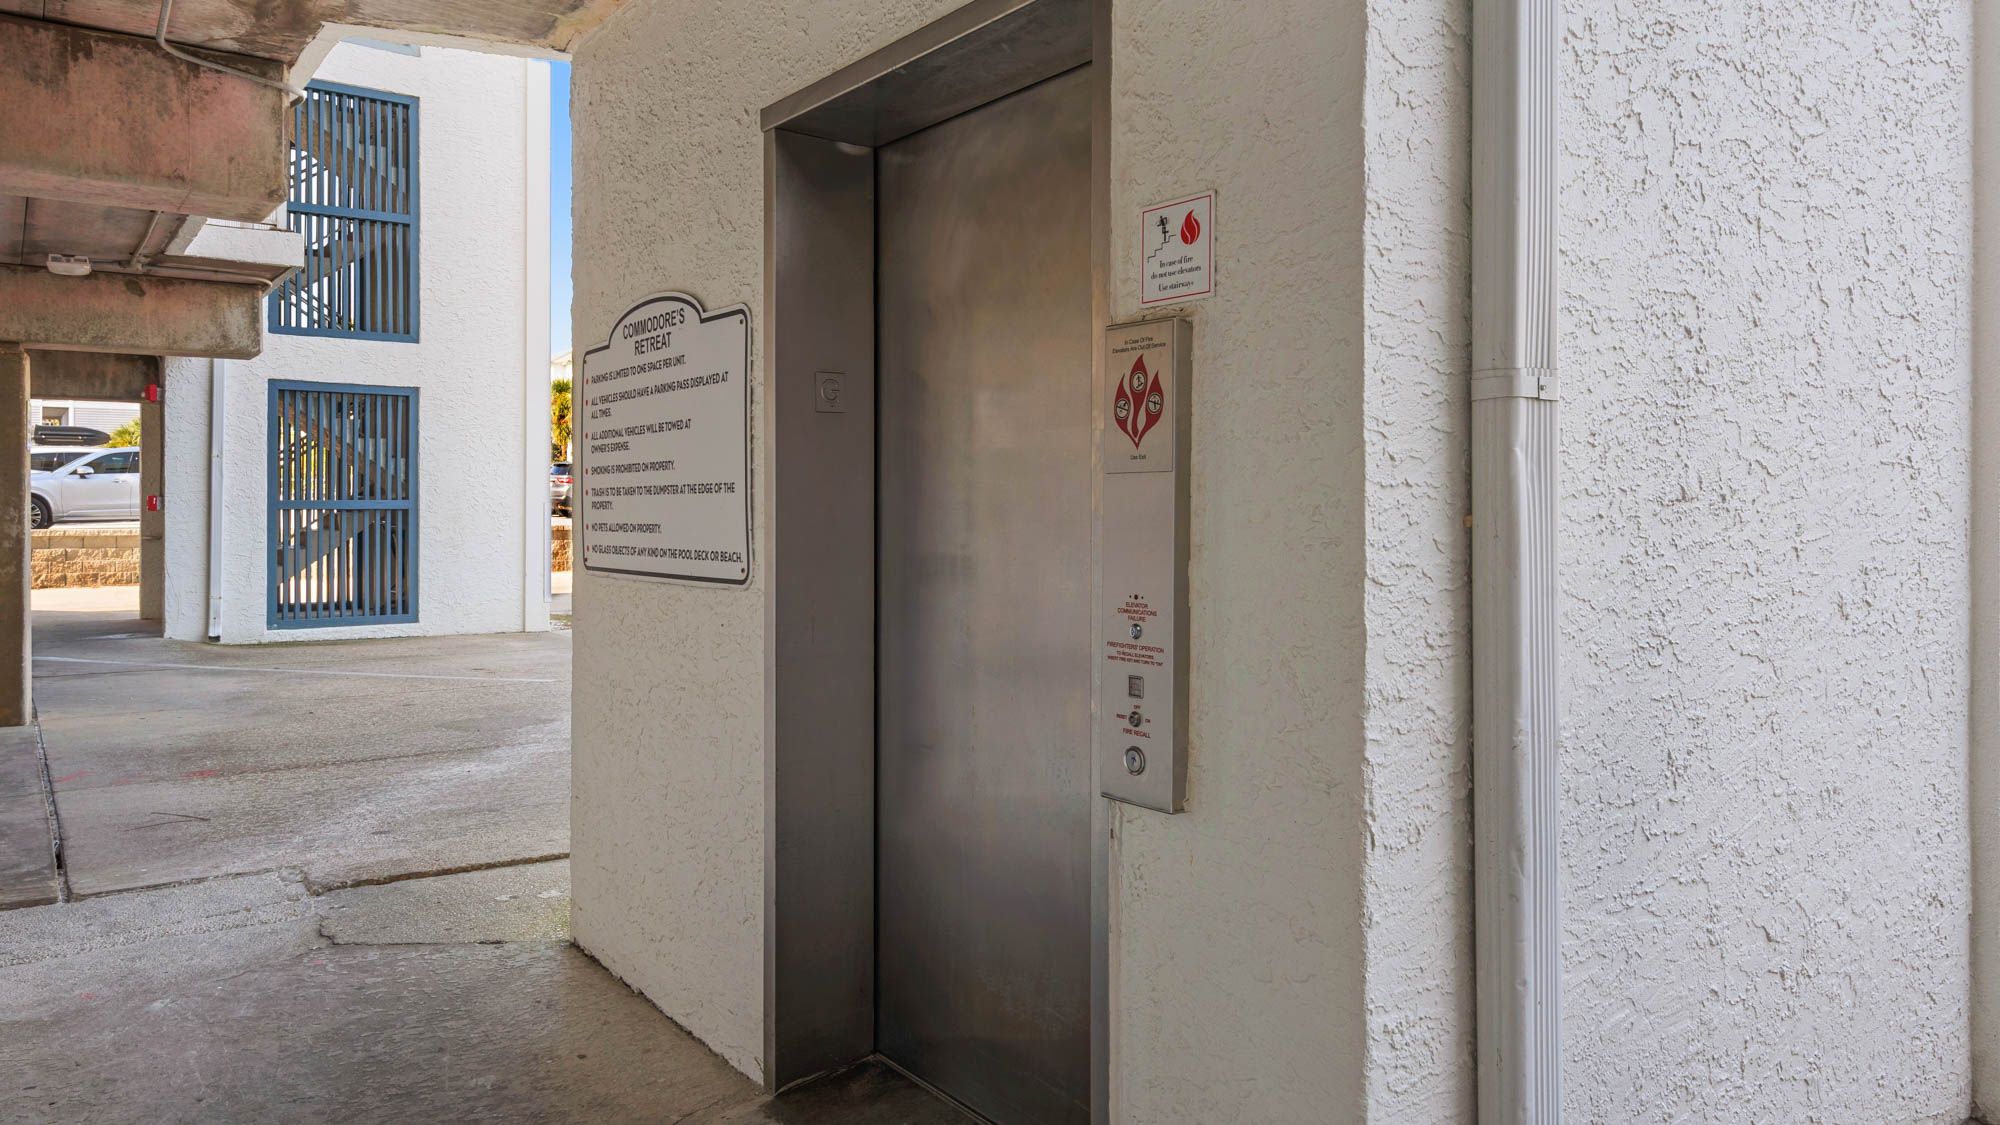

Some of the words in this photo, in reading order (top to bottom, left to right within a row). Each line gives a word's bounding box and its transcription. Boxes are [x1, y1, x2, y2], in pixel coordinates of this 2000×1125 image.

[623, 308, 685, 339] COMMODORE'S
[634, 332, 672, 356] RETREAT
[591, 372, 608, 384] PARKING
[609, 371, 613, 380] IS
[613, 367, 629, 380] LIMITED
[630, 366, 636, 376] TO
[637, 364, 647, 374] ONE
[647, 360, 662, 372] SPACE
[662, 358, 672, 369] PER
[599, 392, 618, 404] VEHICLES
[618, 389, 636, 401] SHOULD
[637, 386, 650, 398] HAVE
[650, 386, 654, 395] A
[654, 381, 676, 394] PARKING
[676, 378, 690, 390] PASS
[690, 373, 720, 388] DISPLAYED
[720, 371, 728, 383] AT
[599, 428, 624, 440] ADDITIONAL
[624, 425, 645, 436] VEHICLES
[646, 423, 657, 433] WILL
[658, 422, 664, 432] BE
[665, 419, 684, 432] TOWED
[684, 418, 691, 429] AT
[610, 441, 630, 452] EXPENSE.
[591, 465, 610, 475] SMOKING
[611, 464, 615, 474] IS
[615, 462, 641, 474] PROHIBITED
[641, 462, 649, 472] ON
[650, 460, 675, 471] PROPERTY.
[591, 488, 604, 497] TRASH
[605, 488, 609, 496] IS
[610, 487, 615, 496] TO
[616, 487, 622, 496] BE
[622, 486, 636, 496] TAKEN
[636, 486, 643, 496] TO
[643, 486, 652, 496] THE
[653, 484, 679, 495] DUMPSTER
[680, 484, 686, 494] AT
[686, 484, 697, 494] THE
[698, 483, 713, 494] EDGE
[714, 482, 722, 494] OF
[723, 482, 735, 493] THE
[592, 523, 597, 532] NO
[598, 523, 608, 532] PETS
[609, 523, 629, 532] ALLOWED
[630, 523, 637, 533] ON
[592, 544, 598, 553] NO
[598, 545, 611, 554] GLASS
[612, 545, 630, 556] OBJECTS
[630, 546, 637, 556] OF
[637, 546, 647, 556] ANY
[647, 547, 659, 558] KIND
[660, 548, 667, 558] ON
[668, 548, 678, 559] THE
[678, 548, 693, 560] POOL
[694, 549, 709, 561] DECK
[710, 550, 720, 562] OR
[720, 550, 743, 563] BEACH.
[1117, 608, 1157, 616] COMMUNICATIONS
[1139, 645, 1164, 653] OPERATION
[1134, 730, 1151, 738] RECALL
